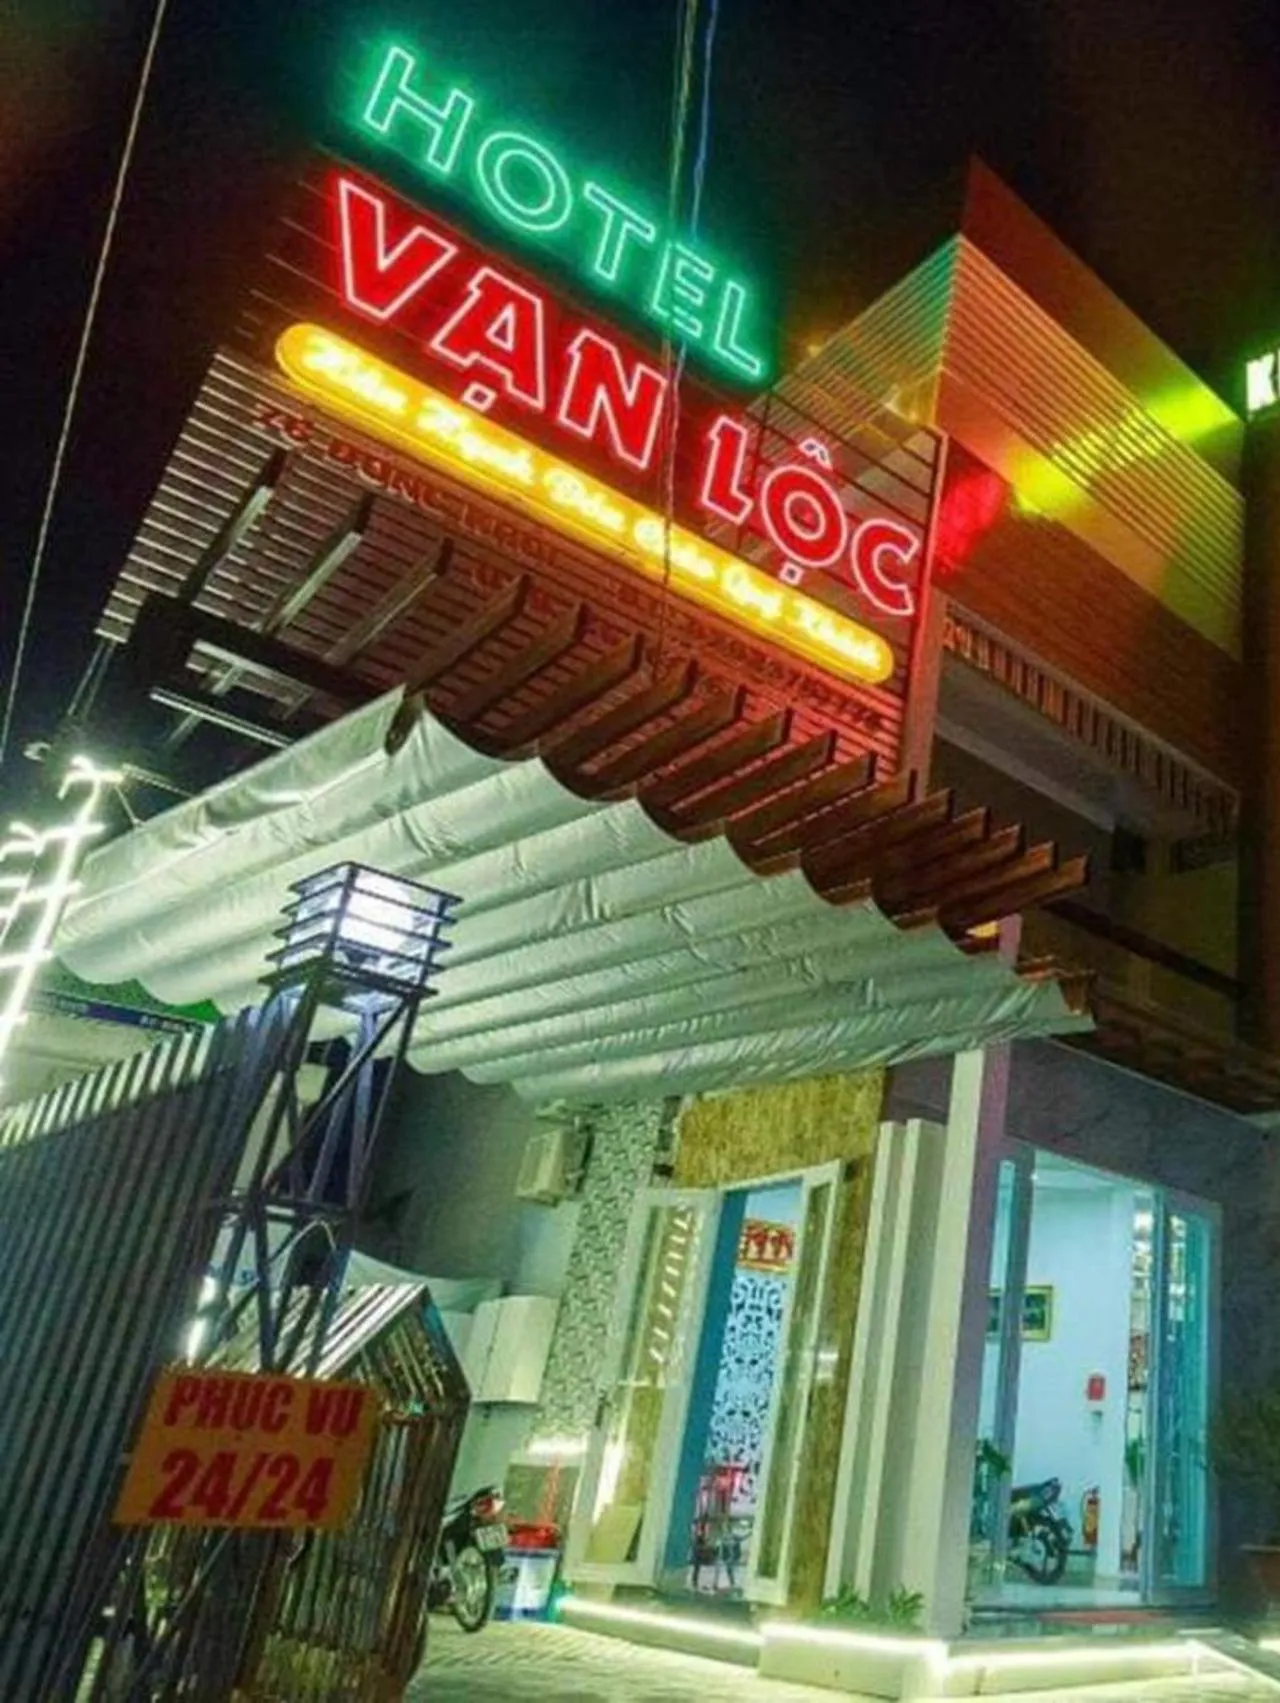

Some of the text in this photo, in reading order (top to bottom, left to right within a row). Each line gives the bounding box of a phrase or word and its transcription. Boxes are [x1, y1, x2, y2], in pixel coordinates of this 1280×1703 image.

[361, 45, 765, 381] HOTEL
[336, 177, 919, 617] VẠN LỘC
[148, 1448, 336, 1523] 24/24
